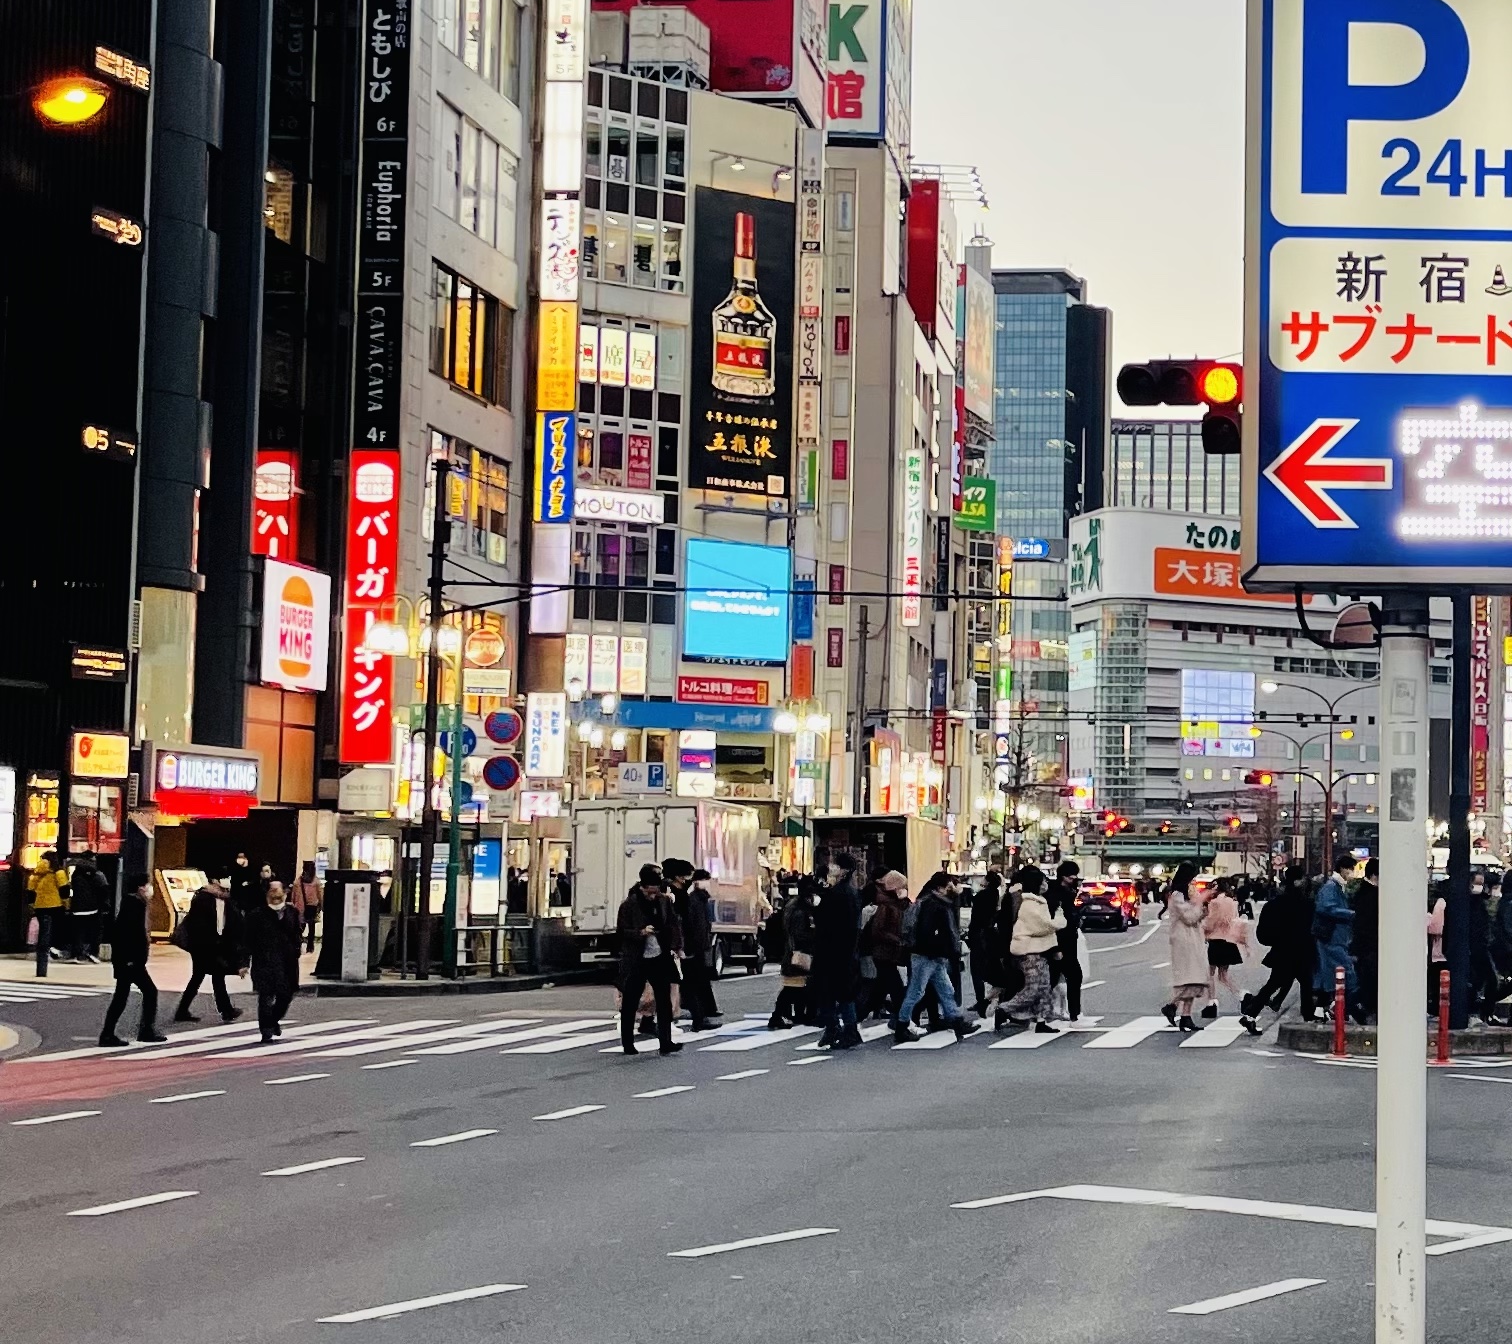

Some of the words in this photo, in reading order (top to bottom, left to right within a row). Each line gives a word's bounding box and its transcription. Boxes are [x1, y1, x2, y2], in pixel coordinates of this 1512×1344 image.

[370, 9, 392, 103] ともしび
[377, 117, 396, 133] 6F
[372, 160, 401, 242] Euphoria
[372, 272, 391, 287] 5F
[1335, 252, 1470, 304] 新宿
[803, 323, 816, 375] MOUTON
[366, 427, 386, 442] 4F
[907, 456, 920, 546] 新宿サンパーク
[1168, 560, 1242, 590] 大塚
[280, 604, 313, 630] BURGER
[353, 511, 391, 732] バーガーキング
[279, 628, 313, 660] KING
[682, 680, 733, 696] トルコ料理
[531, 710, 543, 770] SUNPARK
[179, 758, 226, 789] BURGER
[227, 761, 258, 792] KING
[652, 766, 662, 778] P
